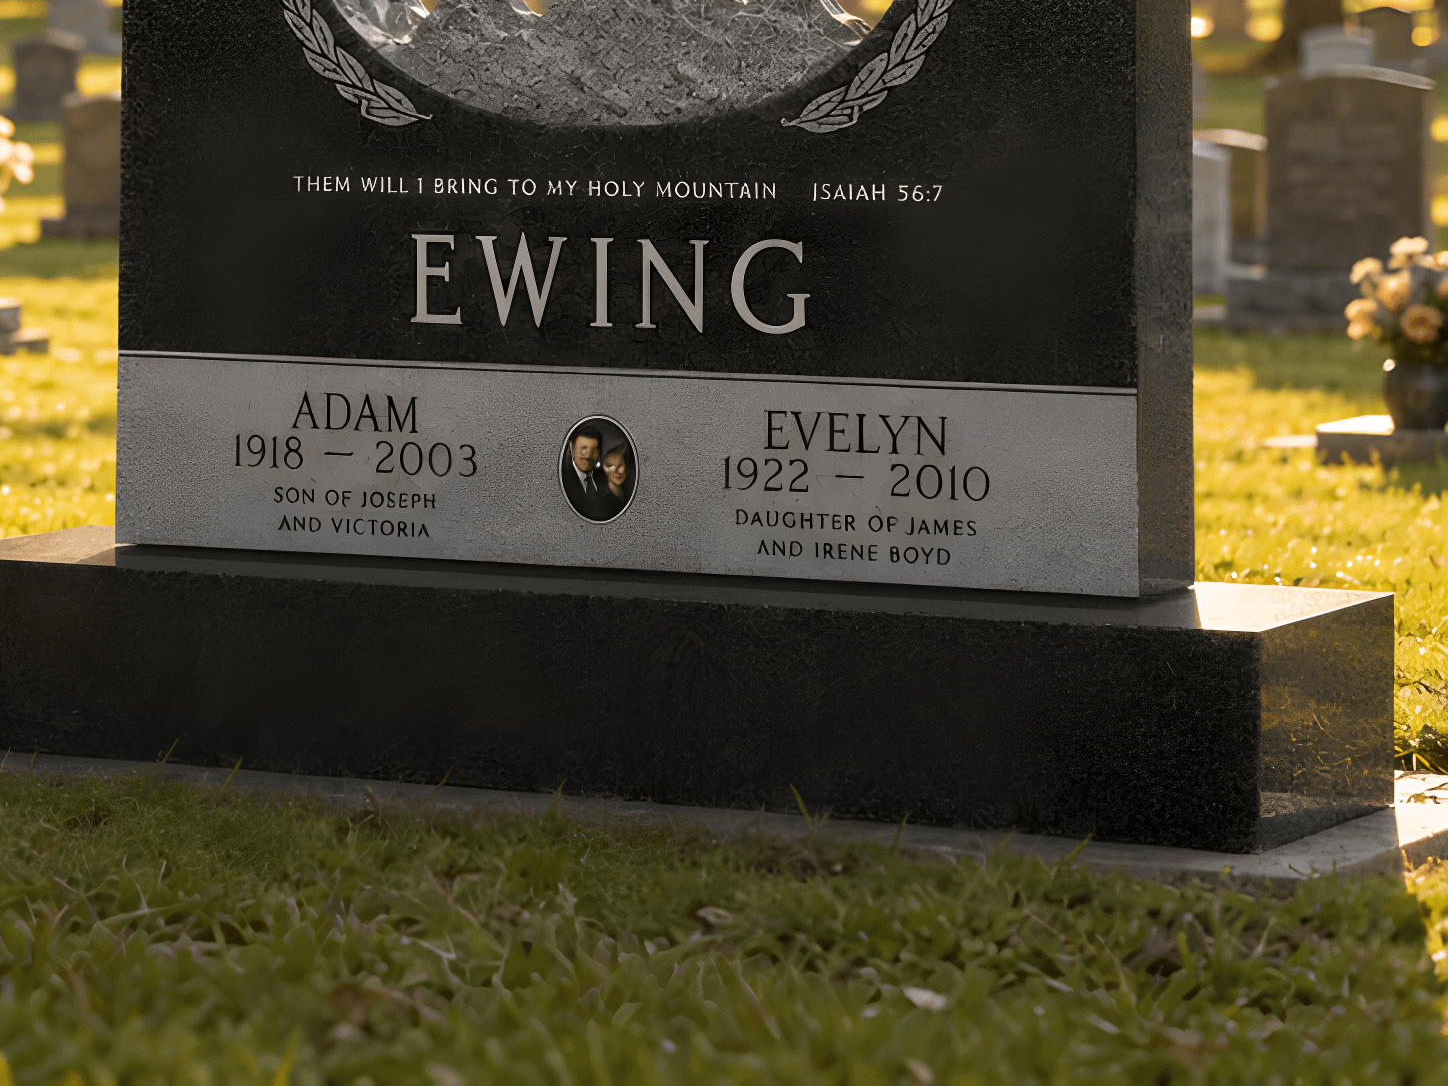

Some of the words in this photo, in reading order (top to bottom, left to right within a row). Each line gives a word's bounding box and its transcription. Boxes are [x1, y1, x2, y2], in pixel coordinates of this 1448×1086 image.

[293, 175, 351, 193] THEM
[360, 176, 409, 194] WILL
[433, 177, 498, 195] BRING
[507, 178, 537, 196] TO
[546, 179, 578, 196] MY
[586, 180, 645, 198] HOLY
[655, 181, 776, 200] MOUNTAIN
[812, 182, 886, 202] ISAIAH
[897, 184, 943, 202] 56:7
[411, 232, 812, 335] EWING
[291, 390, 419, 434] ADAM
[763, 409, 948, 456] EVELYN
[234, 433, 304, 470] 1918
[375, 440, 478, 478] 2003
[724, 455, 810, 493] 1922
[890, 463, 990, 502] 2010
[273, 486, 315, 505] SON
[324, 489, 352, 508] OF
[360, 491, 437, 510] JOSEPH
[277, 514, 322, 533] AND
[330, 517, 430, 538] VICTORIA
[735, 508, 856, 532] DAUGHTER
[904, 516, 977, 537] JAMES
[756, 539, 803, 558] AND
[814, 542, 878, 562] IRENE
[889, 545, 951, 566] BOYD
